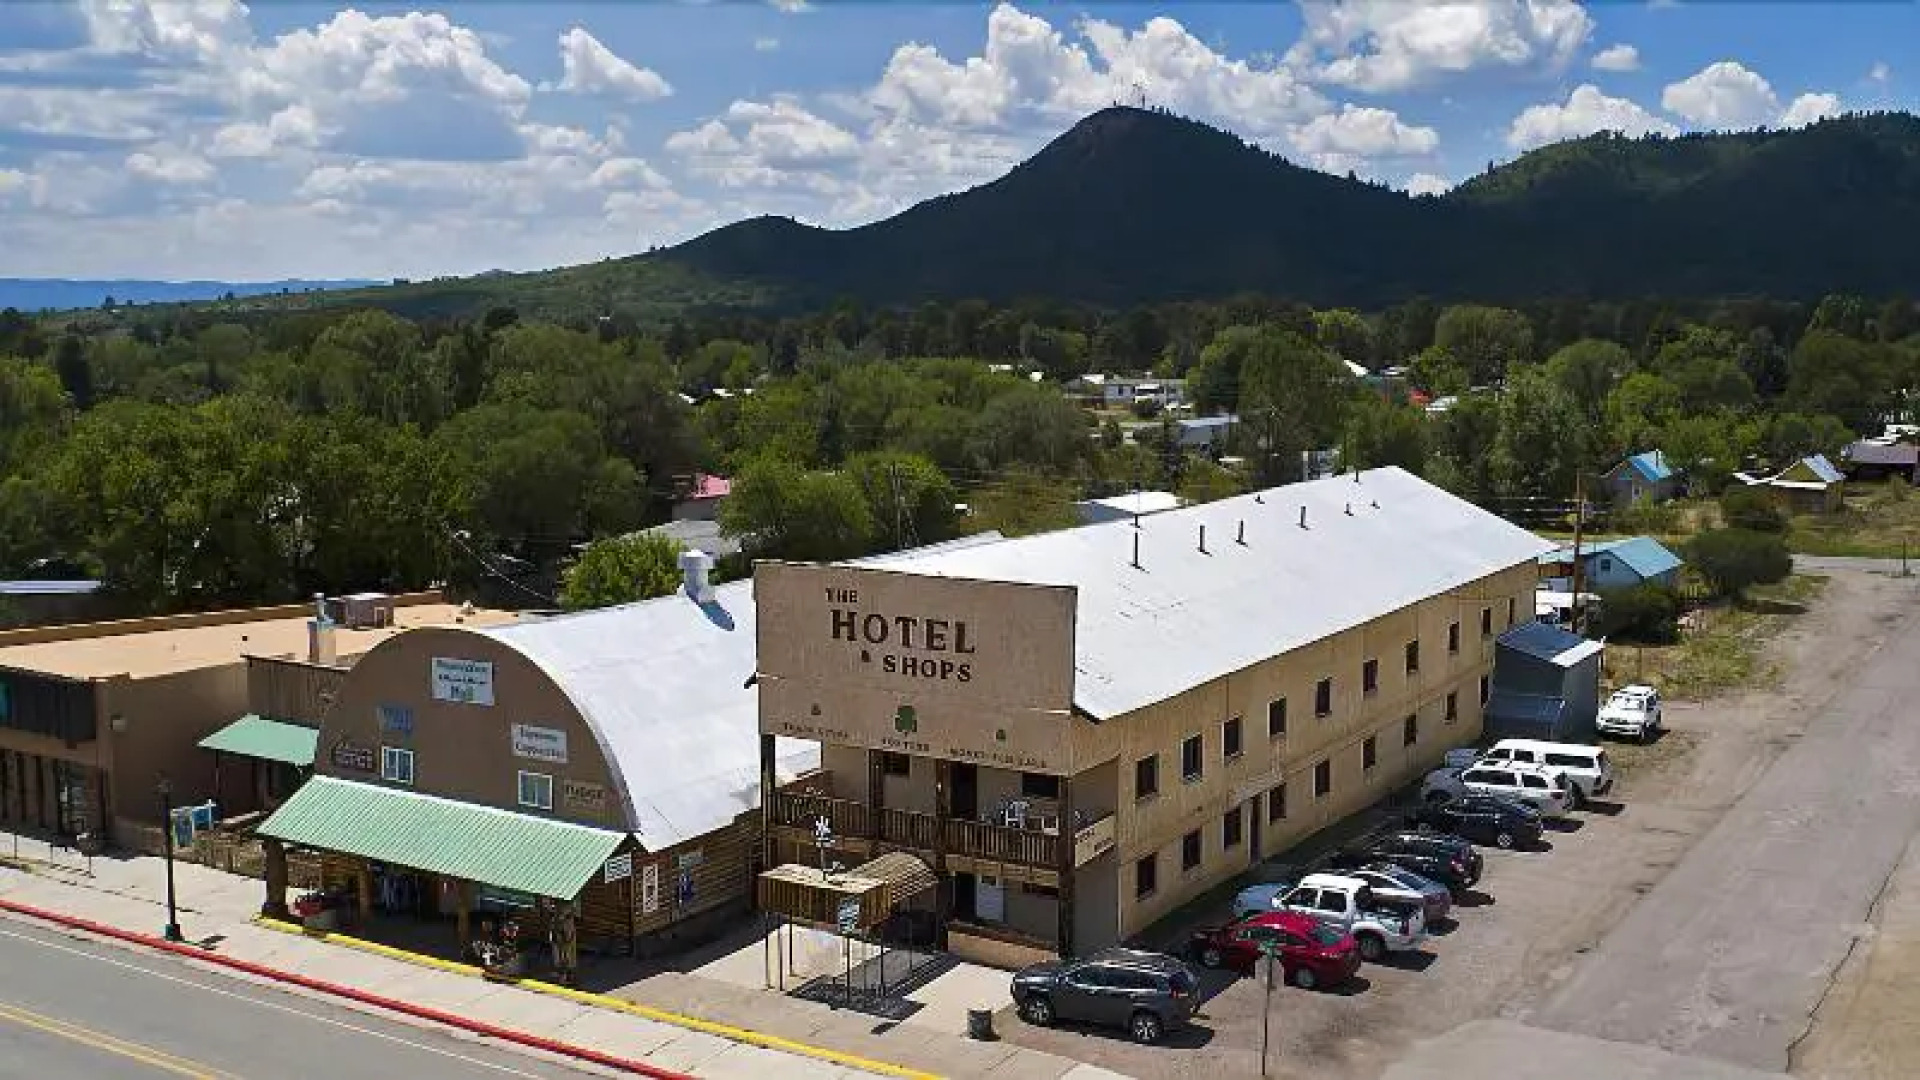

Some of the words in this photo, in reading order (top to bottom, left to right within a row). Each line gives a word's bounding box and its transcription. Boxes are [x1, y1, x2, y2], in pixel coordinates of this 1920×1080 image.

[825, 588, 858, 603] THE
[831, 609, 975, 653] HOTEL
[882, 654, 971, 682] SHOPS
